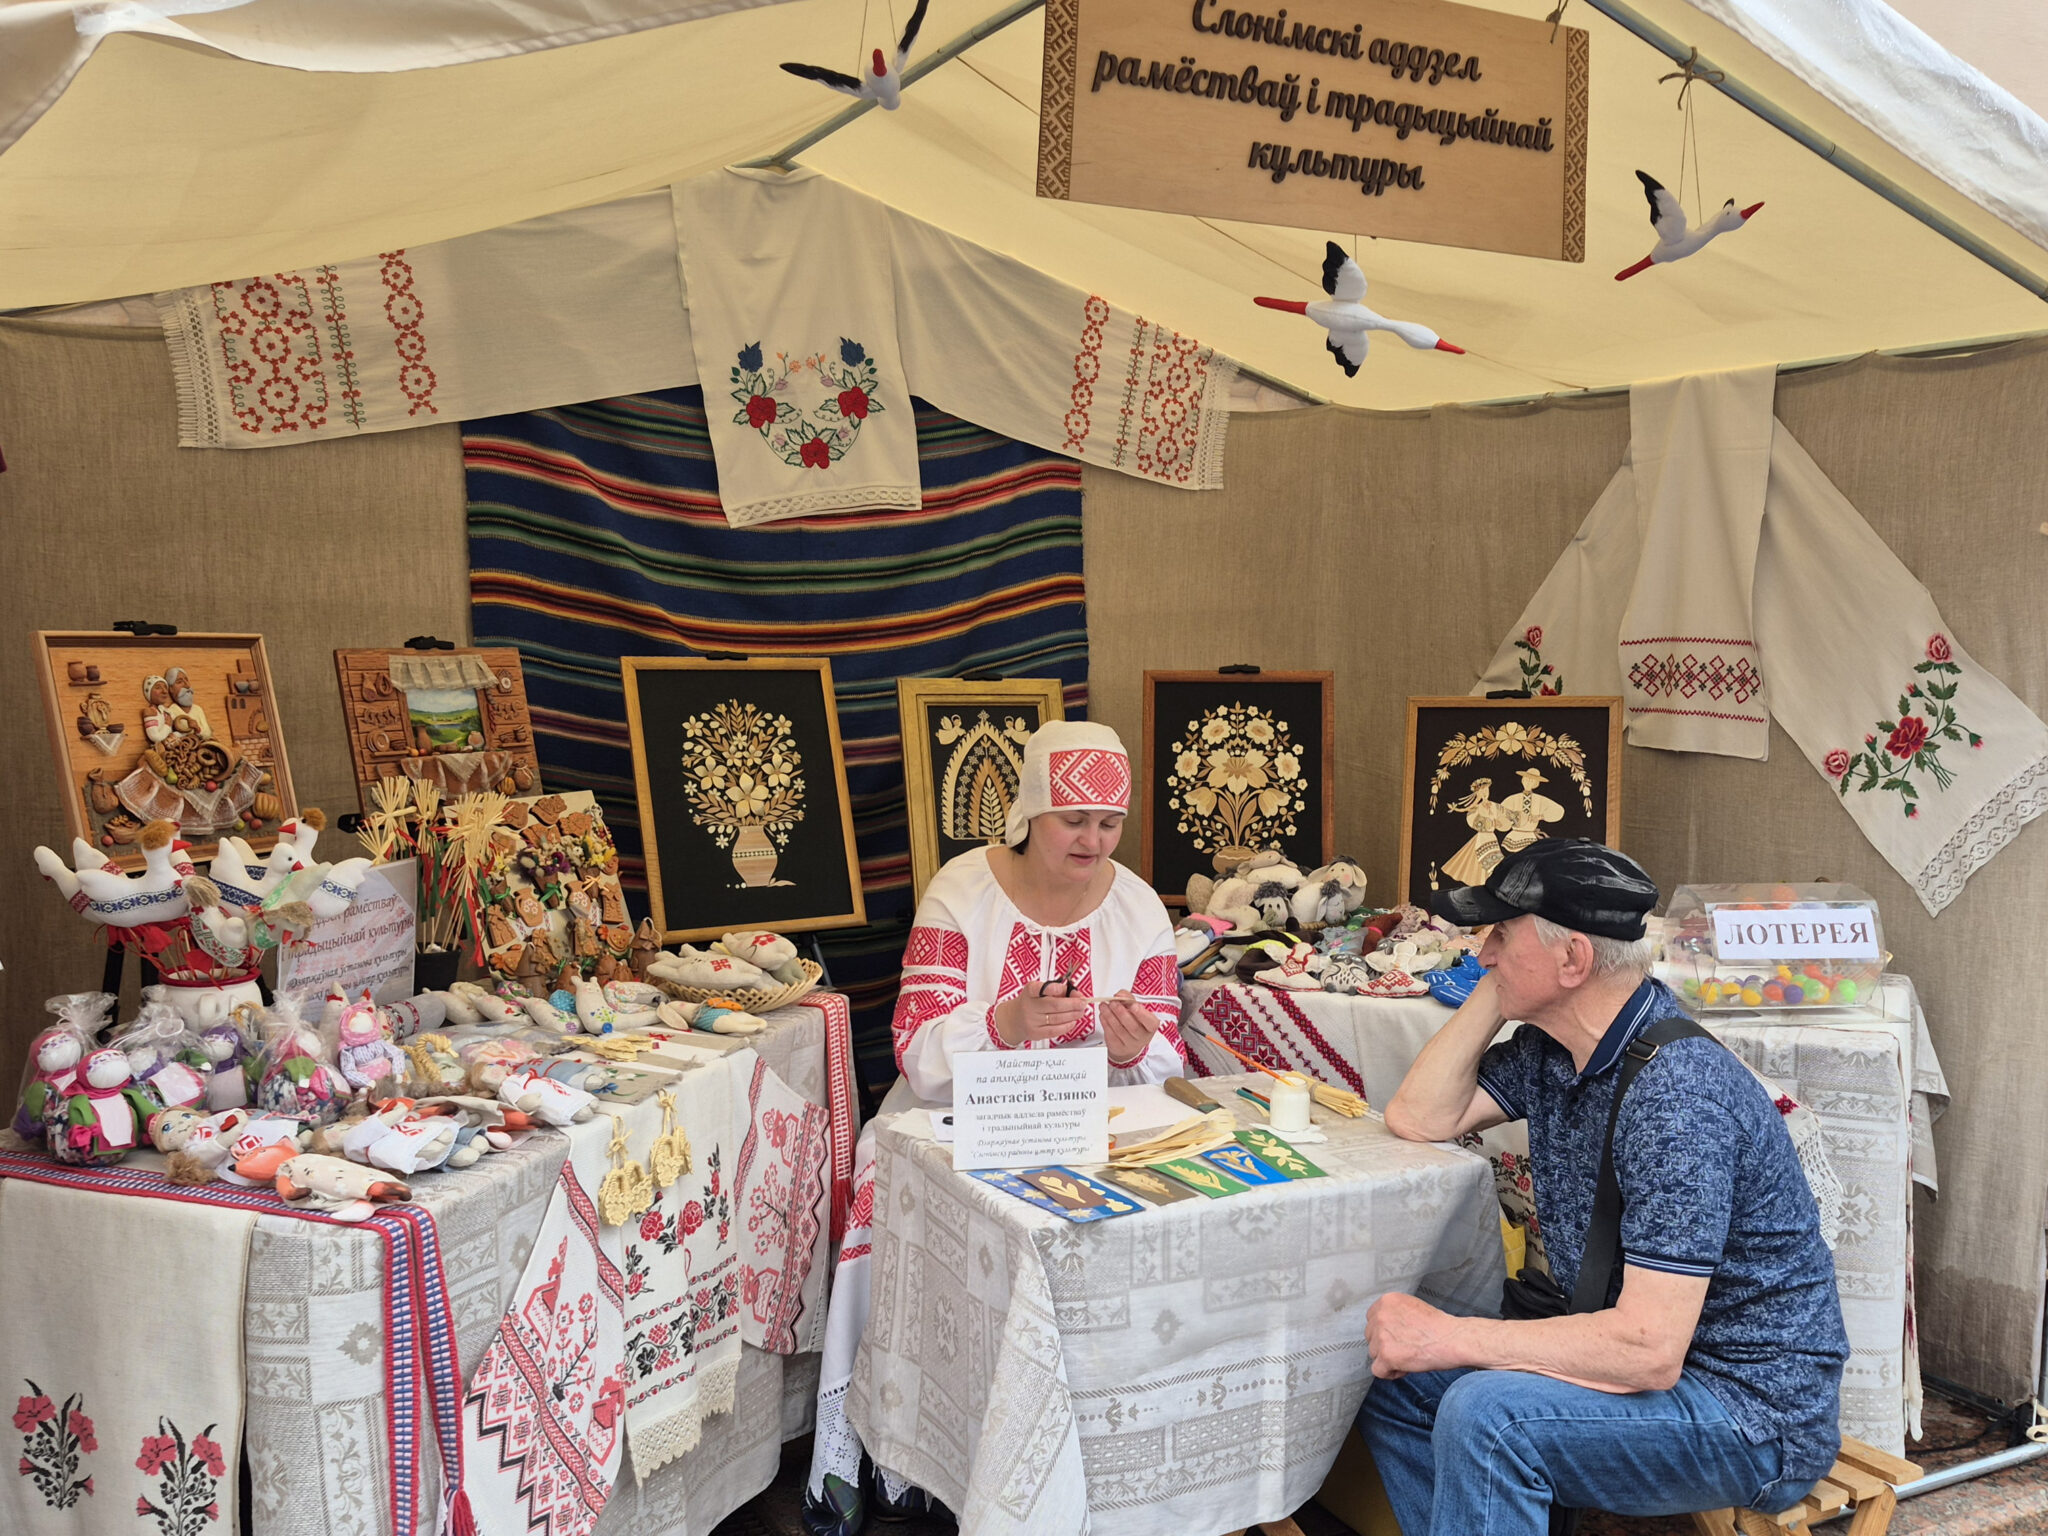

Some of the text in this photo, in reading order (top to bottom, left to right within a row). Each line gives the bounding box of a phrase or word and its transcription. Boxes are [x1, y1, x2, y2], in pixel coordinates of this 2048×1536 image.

[1191, 0, 1482, 86] Слонімскі аддзел
[1091, 48, 1556, 152] рамёстваў і традыцыйнай
[1248, 140, 1425, 196] культуры
[1724, 922, 1870, 945] ЛОТЕРЕЯ
[995, 1059, 1067, 1070] Майстар-клас
[1041, 1070, 1087, 1082] саломкай
[965, 1089, 1097, 1105] Анастасія Зелянко
